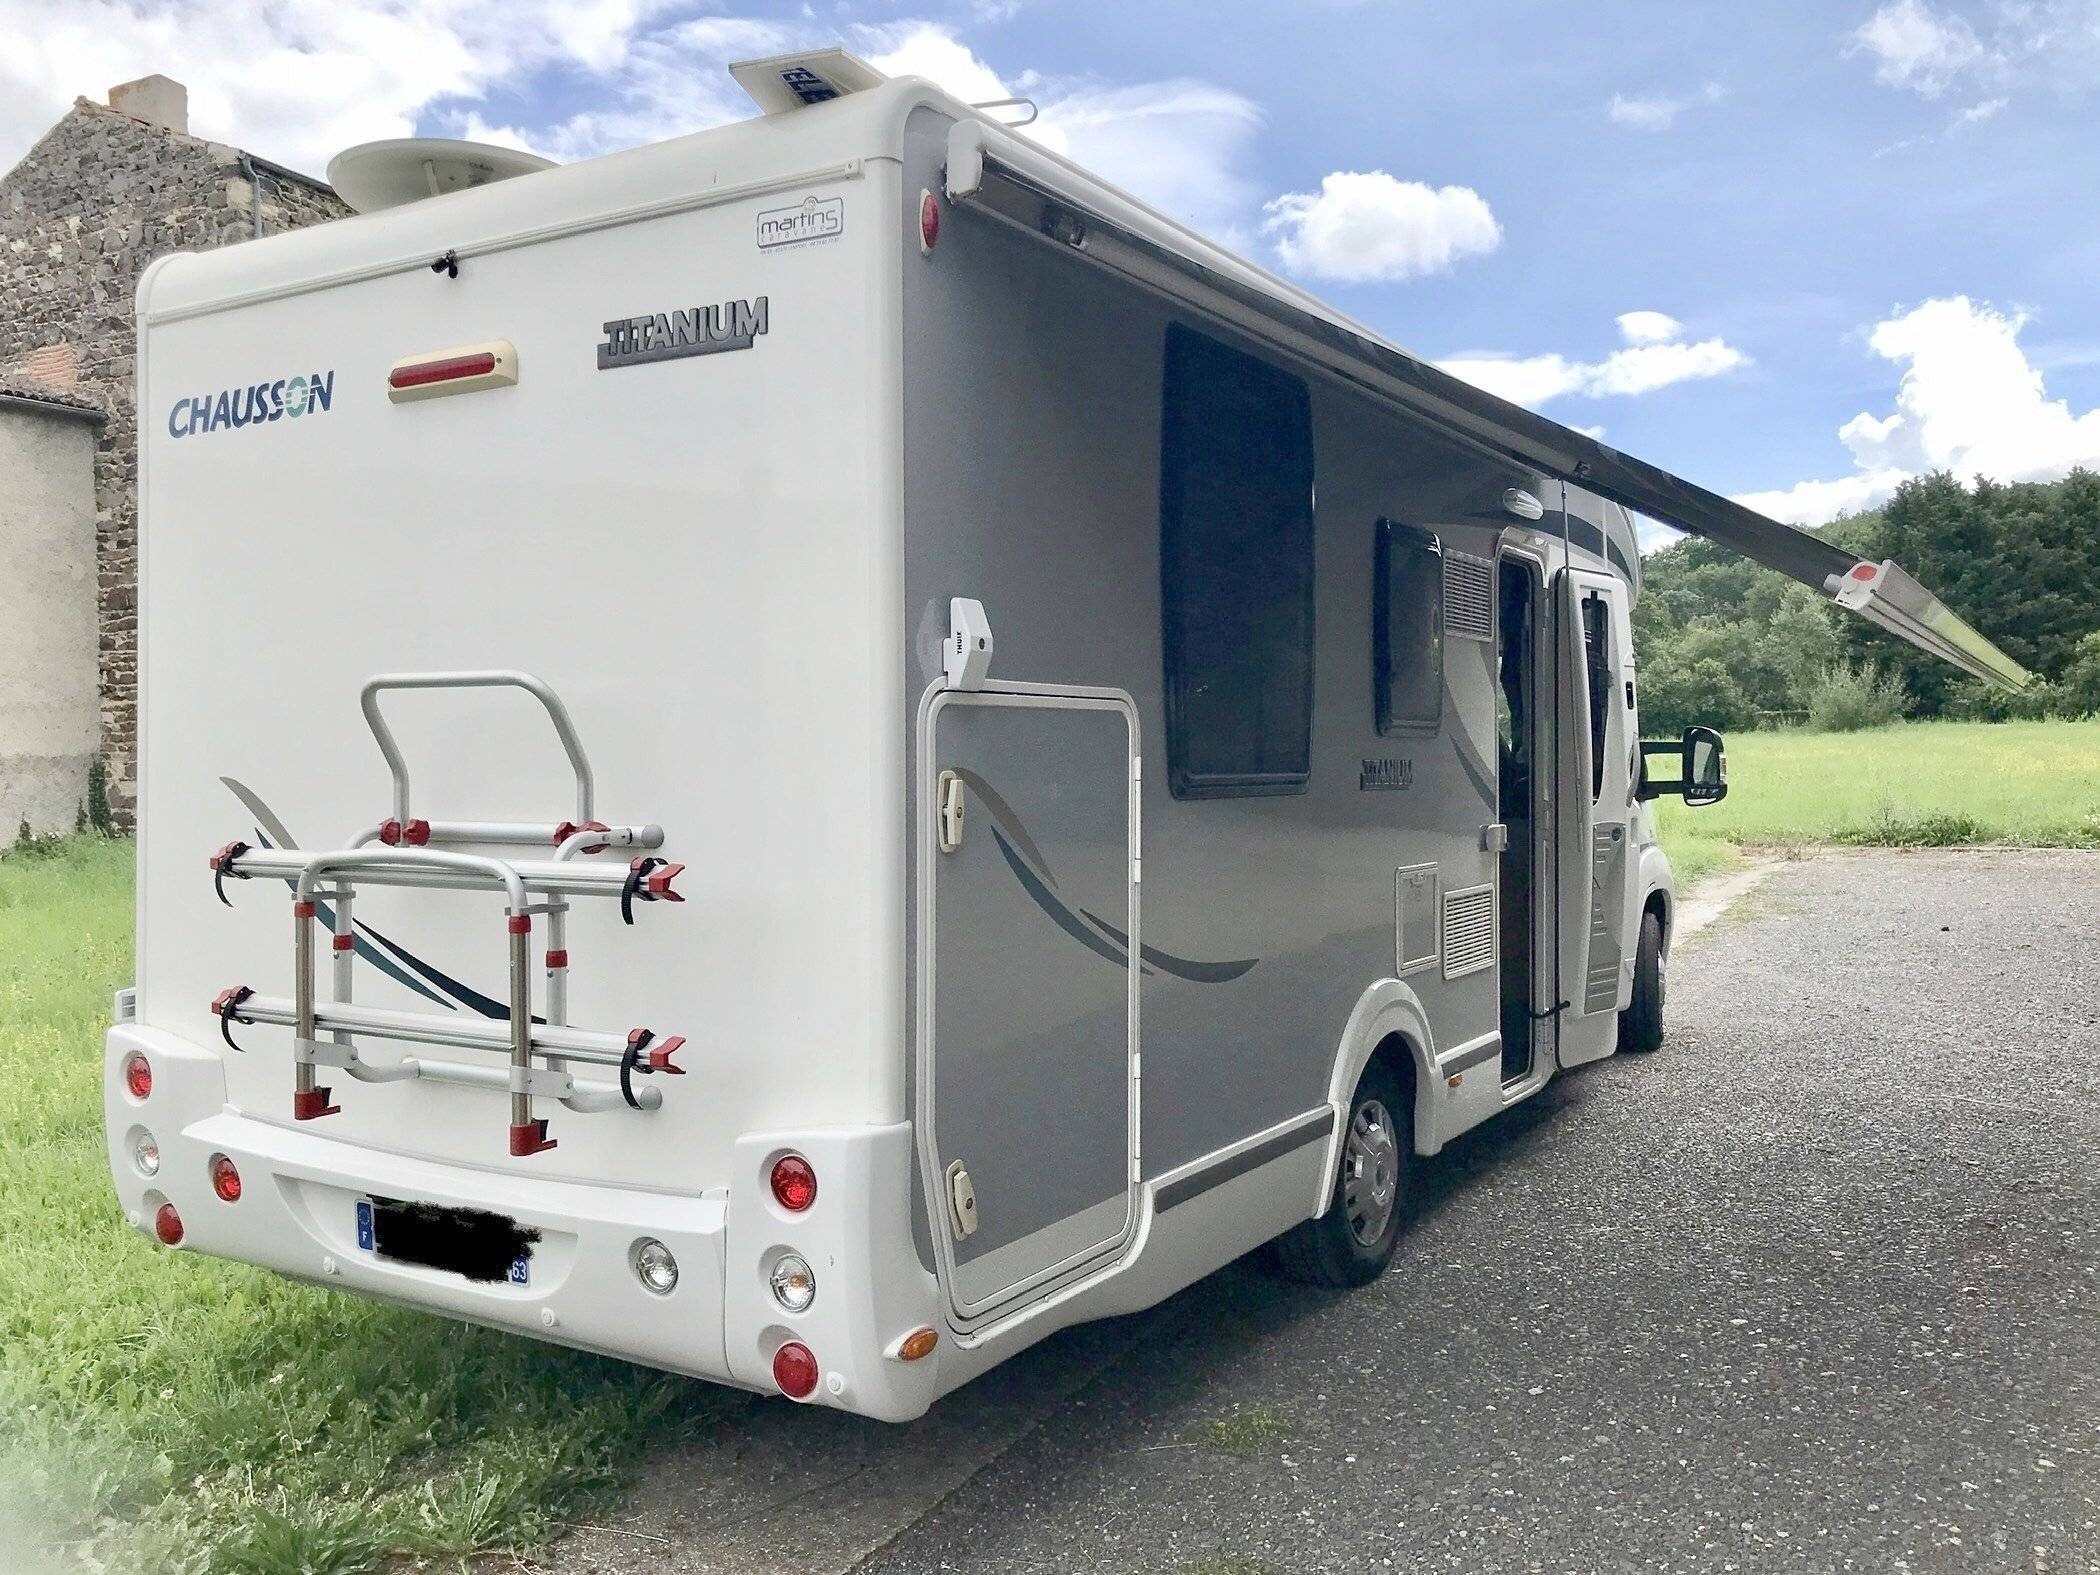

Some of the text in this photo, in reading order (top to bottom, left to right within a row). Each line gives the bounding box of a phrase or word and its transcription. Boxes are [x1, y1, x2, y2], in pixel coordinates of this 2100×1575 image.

[761, 209, 839, 235] martins
[603, 295, 768, 357] TITANIUM
[168, 370, 335, 439] CHAUSSON
[362, 1231, 368, 1242] F
[512, 1261, 527, 1280] 63
